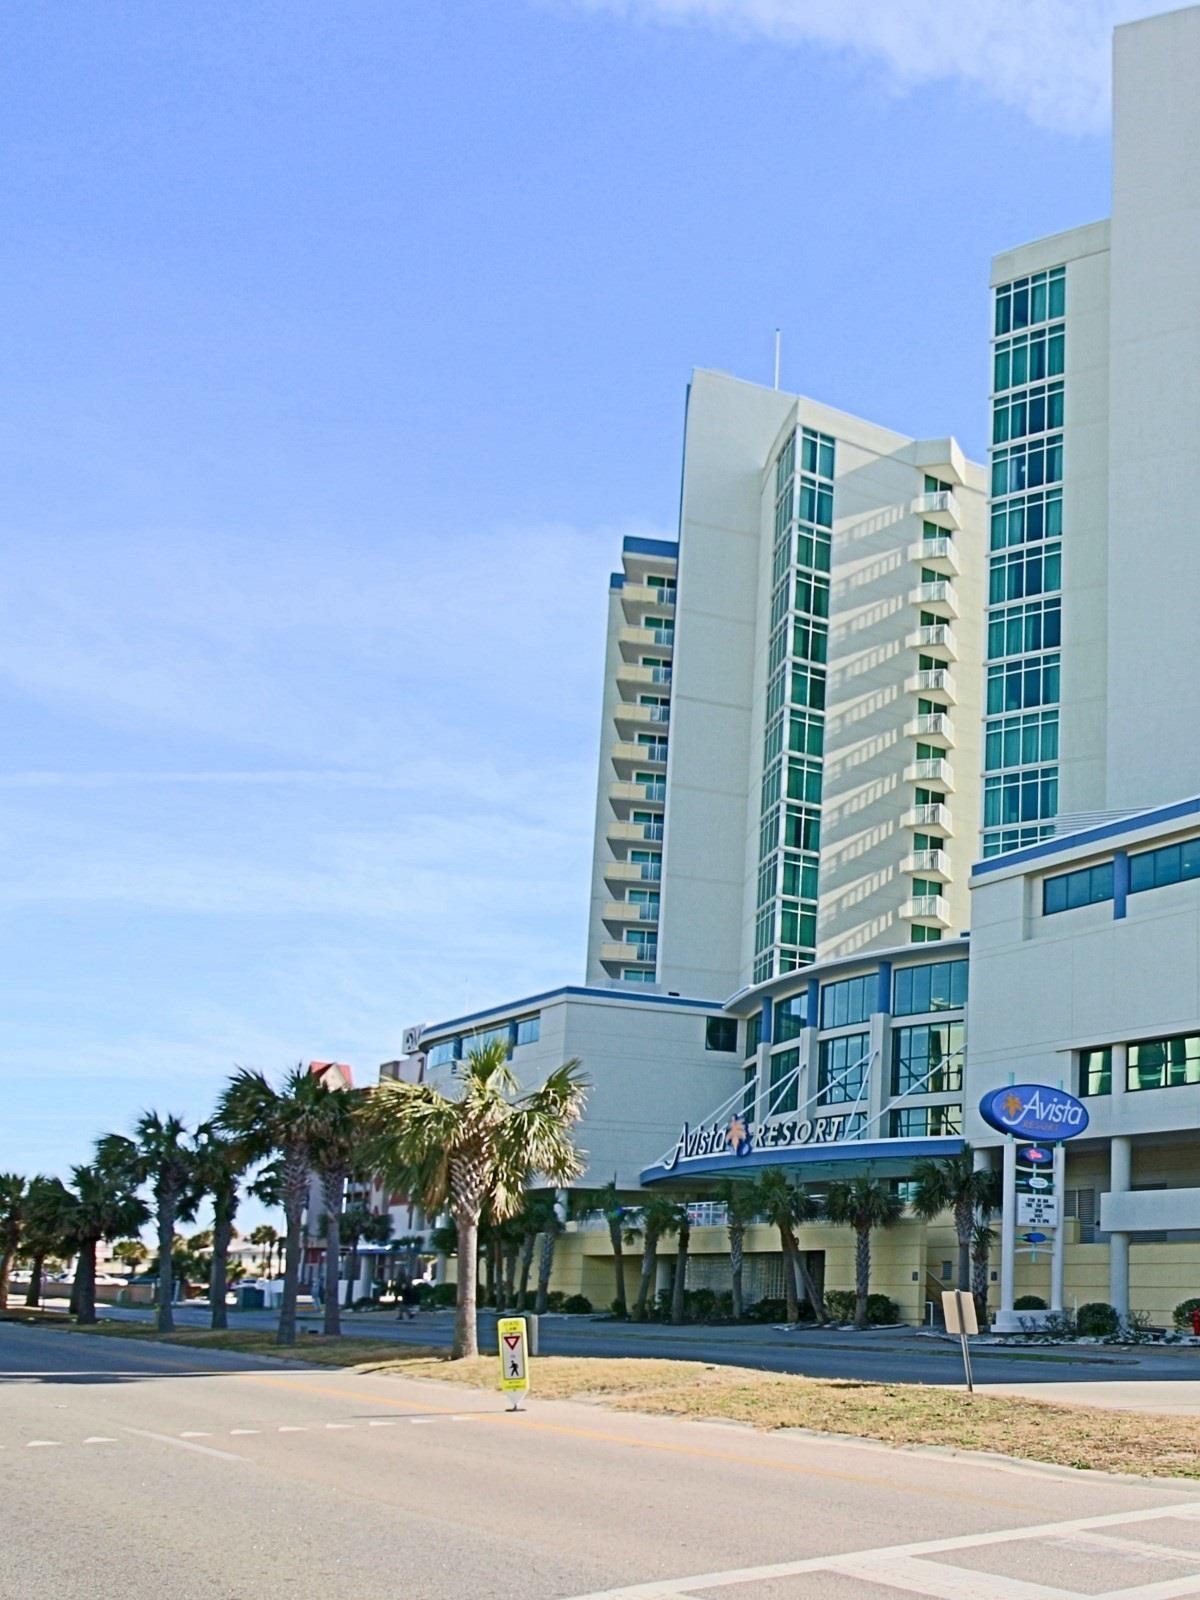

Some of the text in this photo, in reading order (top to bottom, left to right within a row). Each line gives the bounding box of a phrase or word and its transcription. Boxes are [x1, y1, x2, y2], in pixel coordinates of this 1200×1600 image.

[1001, 1090, 1083, 1125] Avista
[663, 1117, 843, 1170] Avista RESORT
